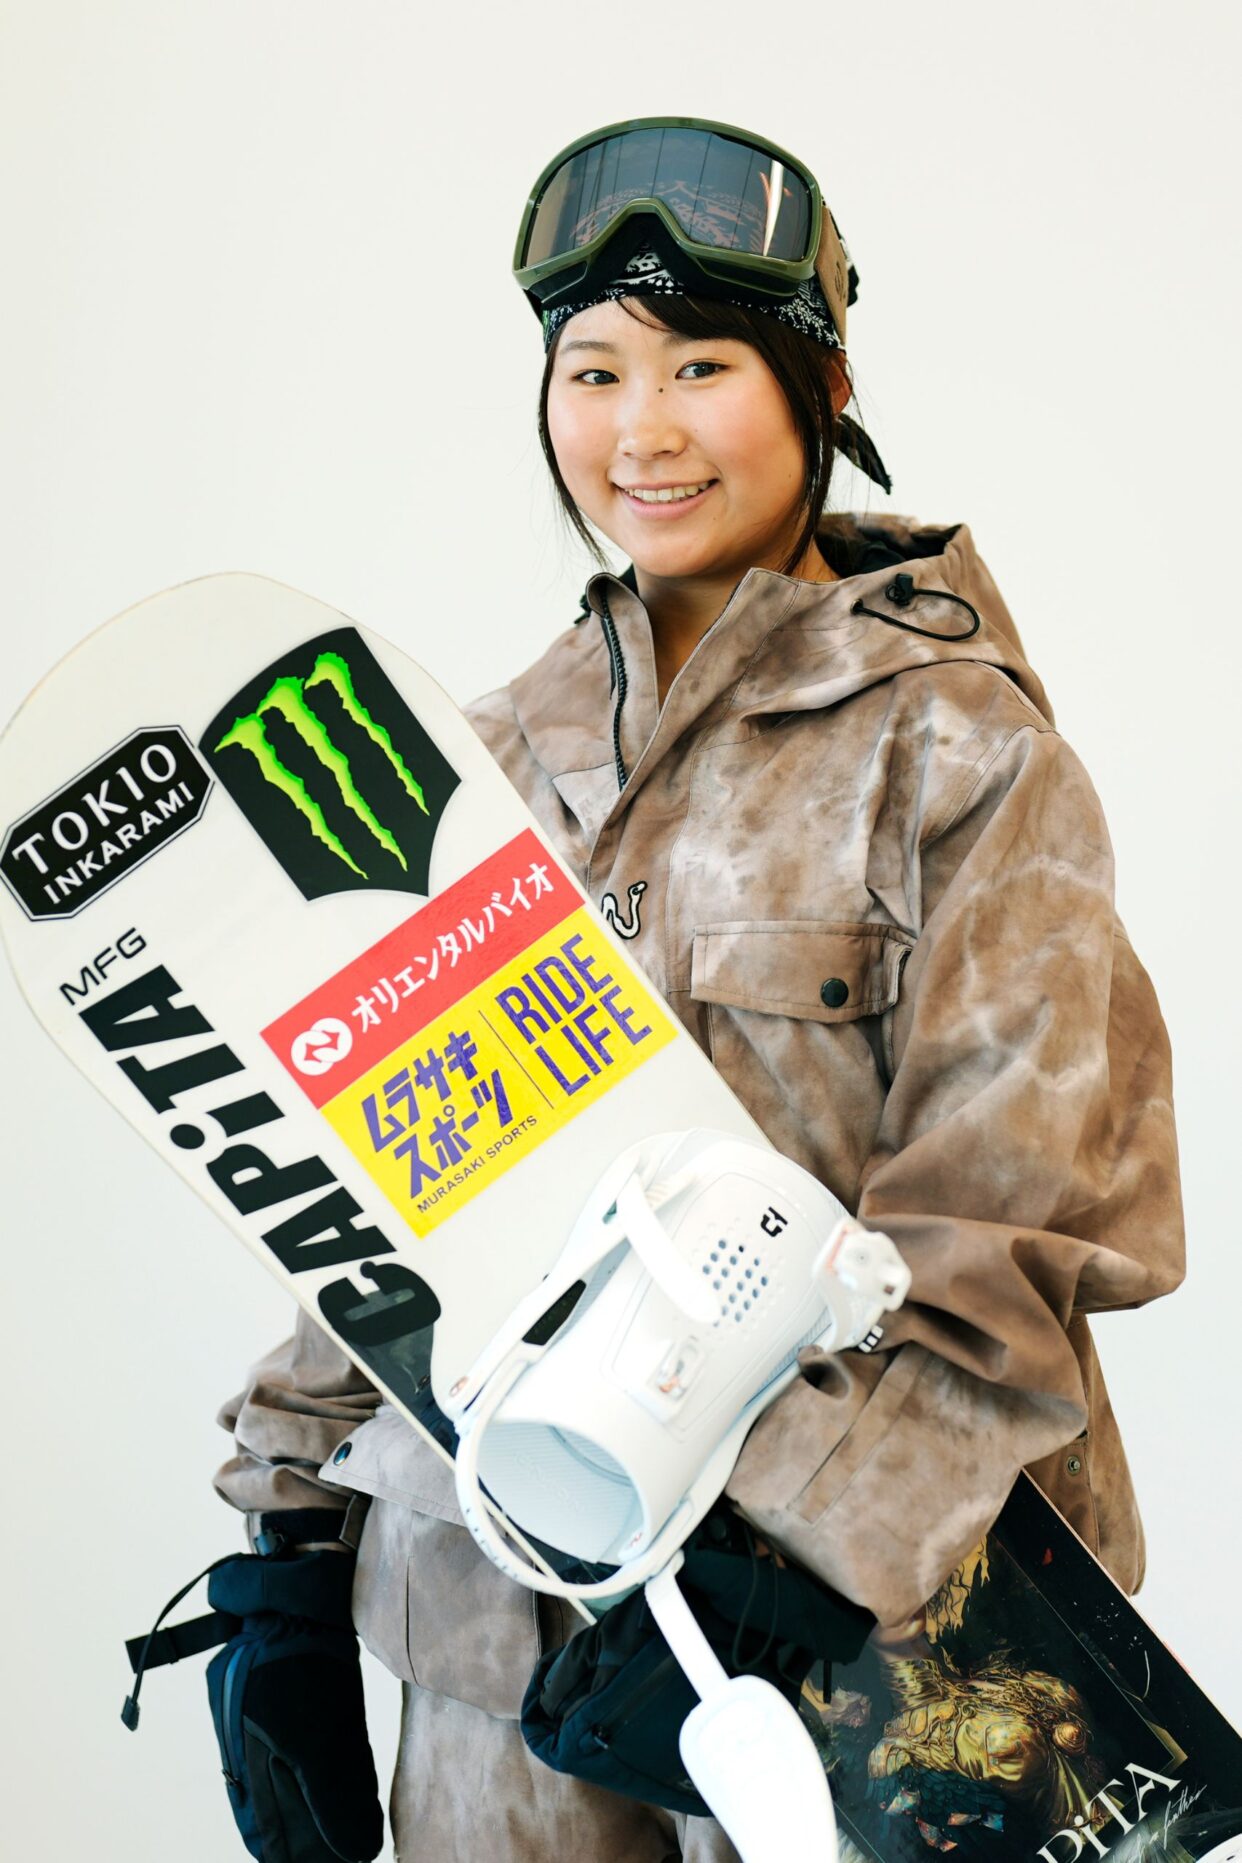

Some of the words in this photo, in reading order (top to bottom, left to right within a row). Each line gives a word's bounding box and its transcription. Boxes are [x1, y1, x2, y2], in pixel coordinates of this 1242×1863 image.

[13, 744, 176, 874] TOKIO
[44, 782, 195, 904] INKARAMI
[59, 927, 147, 1006] MFG
[352, 863, 555, 1032] オリエンタルバイオ
[495, 934, 612, 1043] RIDE
[361, 1031, 477, 1152] ムラサキ
[535, 985, 651, 1095] LIFE
[393, 1070, 513, 1198] スポーツ
[418, 1157, 485, 1212] MURASAKI
[487, 1115, 537, 1159] SPORTS
